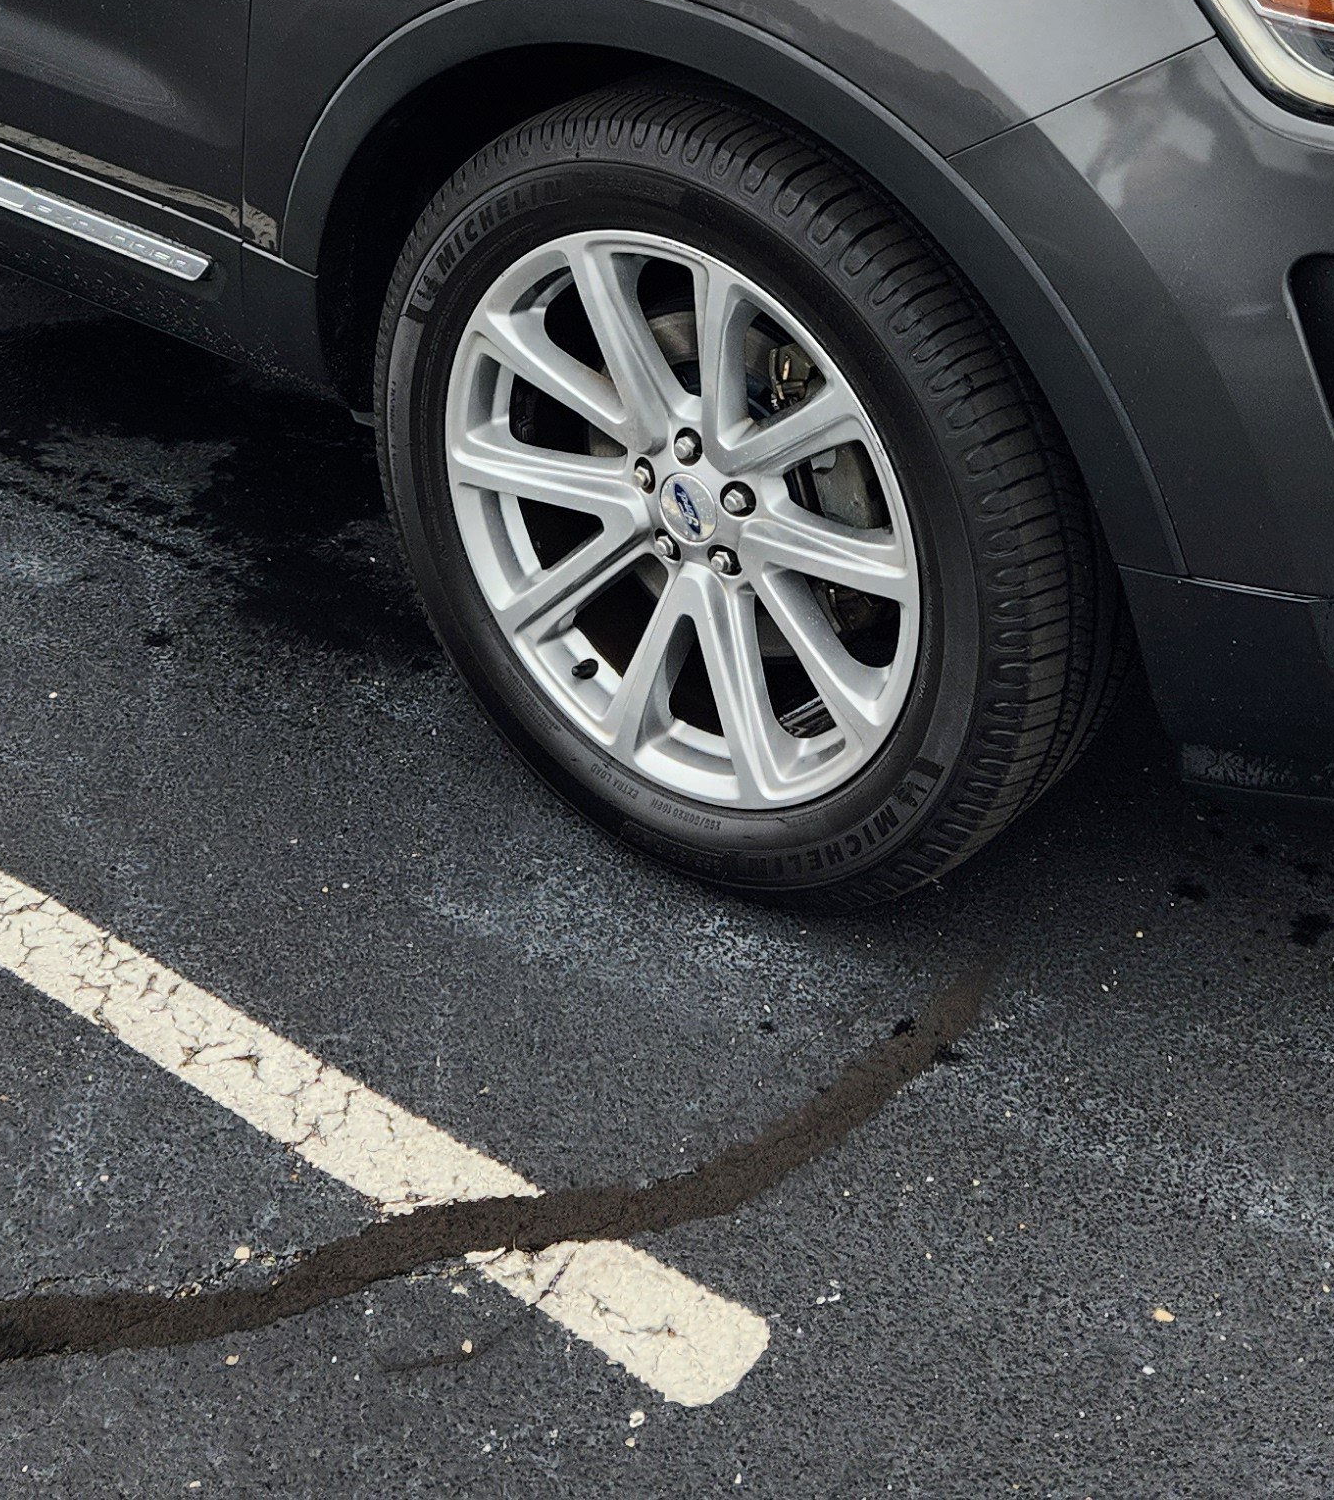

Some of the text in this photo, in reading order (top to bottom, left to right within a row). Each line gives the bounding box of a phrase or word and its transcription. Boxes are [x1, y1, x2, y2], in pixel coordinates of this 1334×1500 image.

[437, 179, 565, 275] MICHELIN
[676, 491, 699, 526] Ford
[748, 805, 901, 879] MICHELIN
